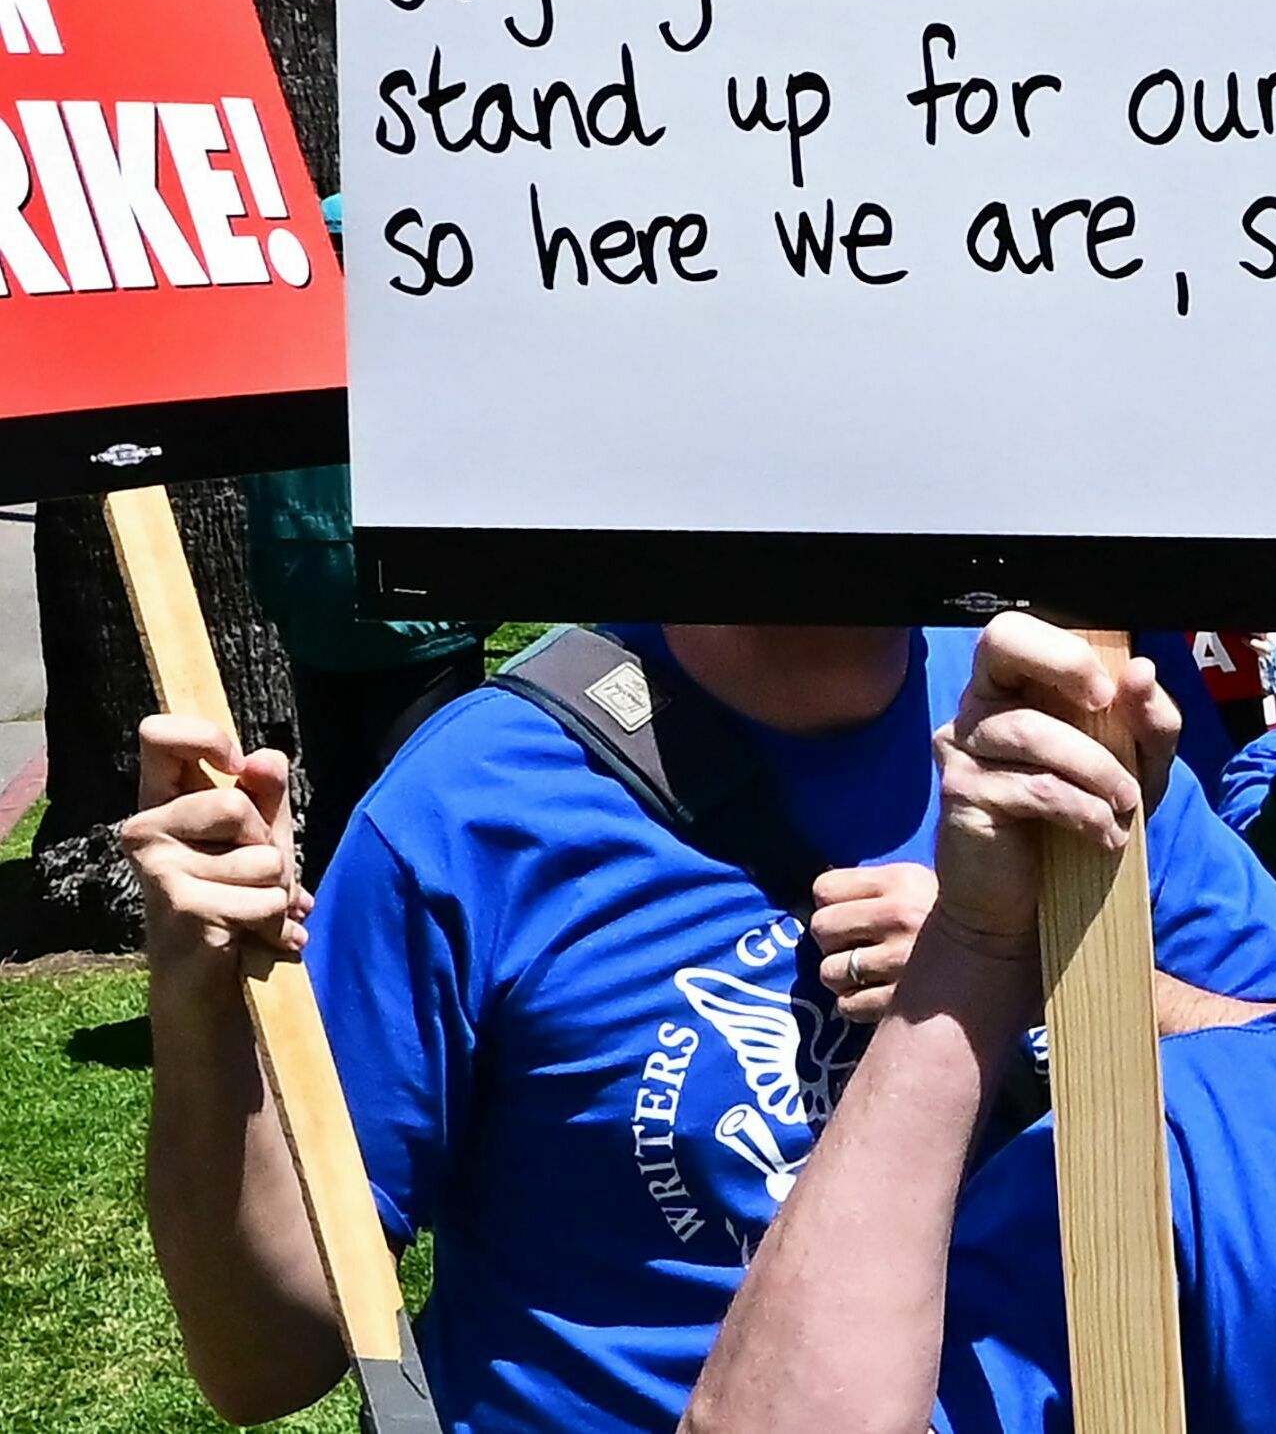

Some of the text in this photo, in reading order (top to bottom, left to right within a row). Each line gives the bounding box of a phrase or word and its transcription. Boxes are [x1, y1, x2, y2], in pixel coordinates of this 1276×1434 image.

[376, 46, 666, 154] stand
[728, 72, 830, 187] up
[907, 23, 1061, 145] for
[385, 208, 473, 296] so
[530, 183, 717, 290] here
[775, 199, 908, 284] we
[967, 196, 1189, 316] are,
[630, 1021, 706, 1244] WRITERS
